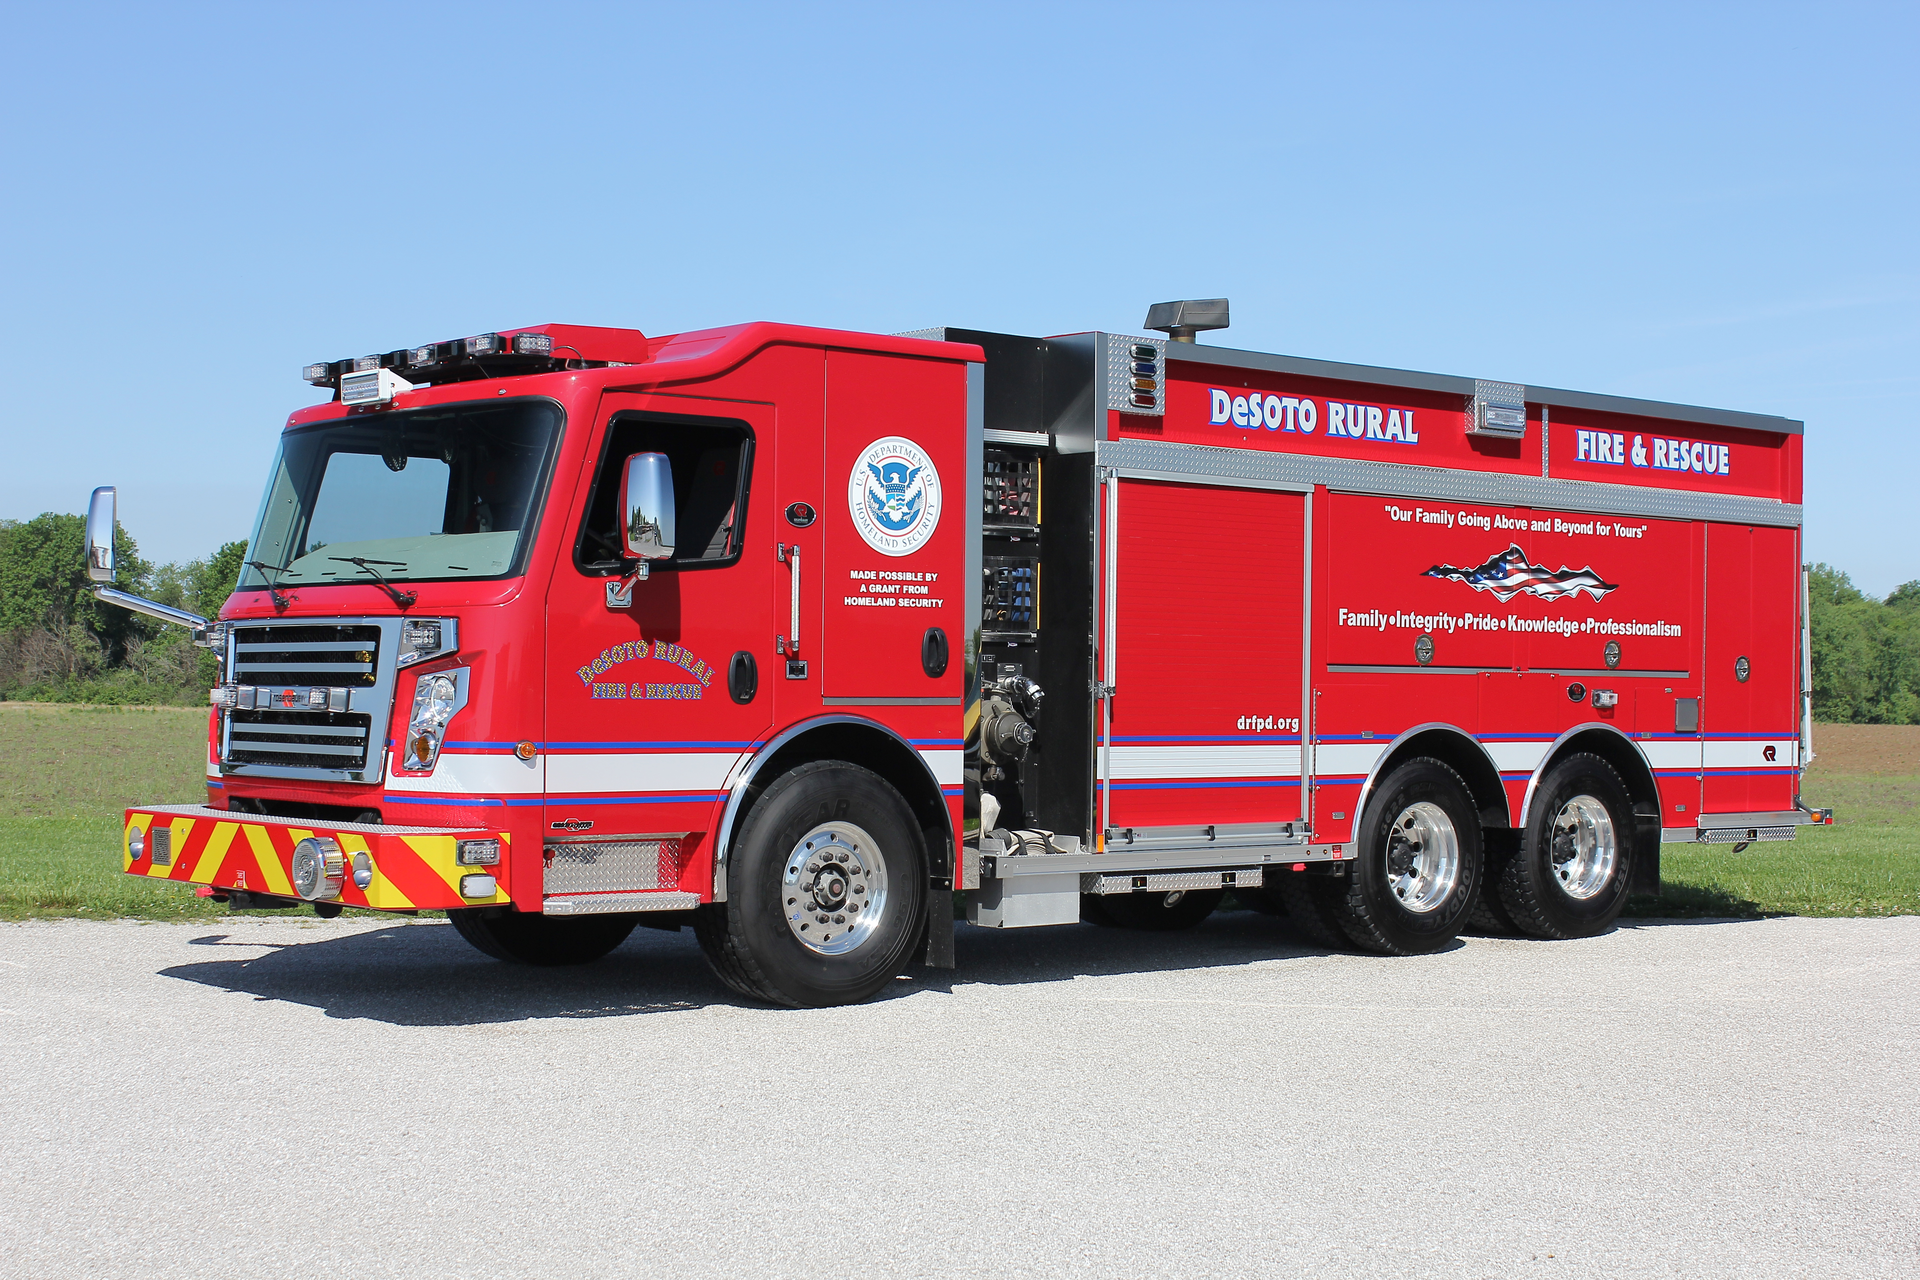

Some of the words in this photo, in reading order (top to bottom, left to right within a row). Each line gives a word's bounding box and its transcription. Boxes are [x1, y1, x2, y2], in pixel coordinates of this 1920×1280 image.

[1208, 388, 1317, 434] DeSOTO
[1324, 401, 1419, 444] RURAL
[868, 444, 928, 472] DEPARTMENT
[925, 473, 935, 489] OF
[1574, 429, 1626, 463] FIRE
[1629, 435, 1650, 467] &
[1652, 438, 1731, 476] RESCUE
[855, 501, 899, 549] HOMELAND
[902, 501, 935, 548] SECURITY
[1385, 506, 1412, 521] "Our
[1415, 508, 1455, 529] Family
[1458, 511, 1491, 532] Going
[1494, 514, 1528, 530] Above
[1530, 519, 1552, 533] and
[1553, 518, 1594, 537] Beyond
[1595, 522, 1612, 536] for
[1613, 523, 1648, 539] Yours"
[850, 570, 877, 580] MADE
[879, 570, 923, 582] POSSIBLE
[925, 572, 938, 582] BY
[859, 583, 868, 593] A
[869, 583, 901, 594] GRANT
[903, 585, 929, 595] FROM
[844, 596, 896, 607] HOMELAND
[898, 597, 944, 608] SECURITY
[576, 639, 649, 687] DeSOTO
[652, 639, 715, 688] RURAL
[591, 682, 627, 699] FIRE
[629, 682, 644, 699] &
[645, 682, 702, 700] RESCUE
[1236, 715, 1300, 733] drfpd.org
